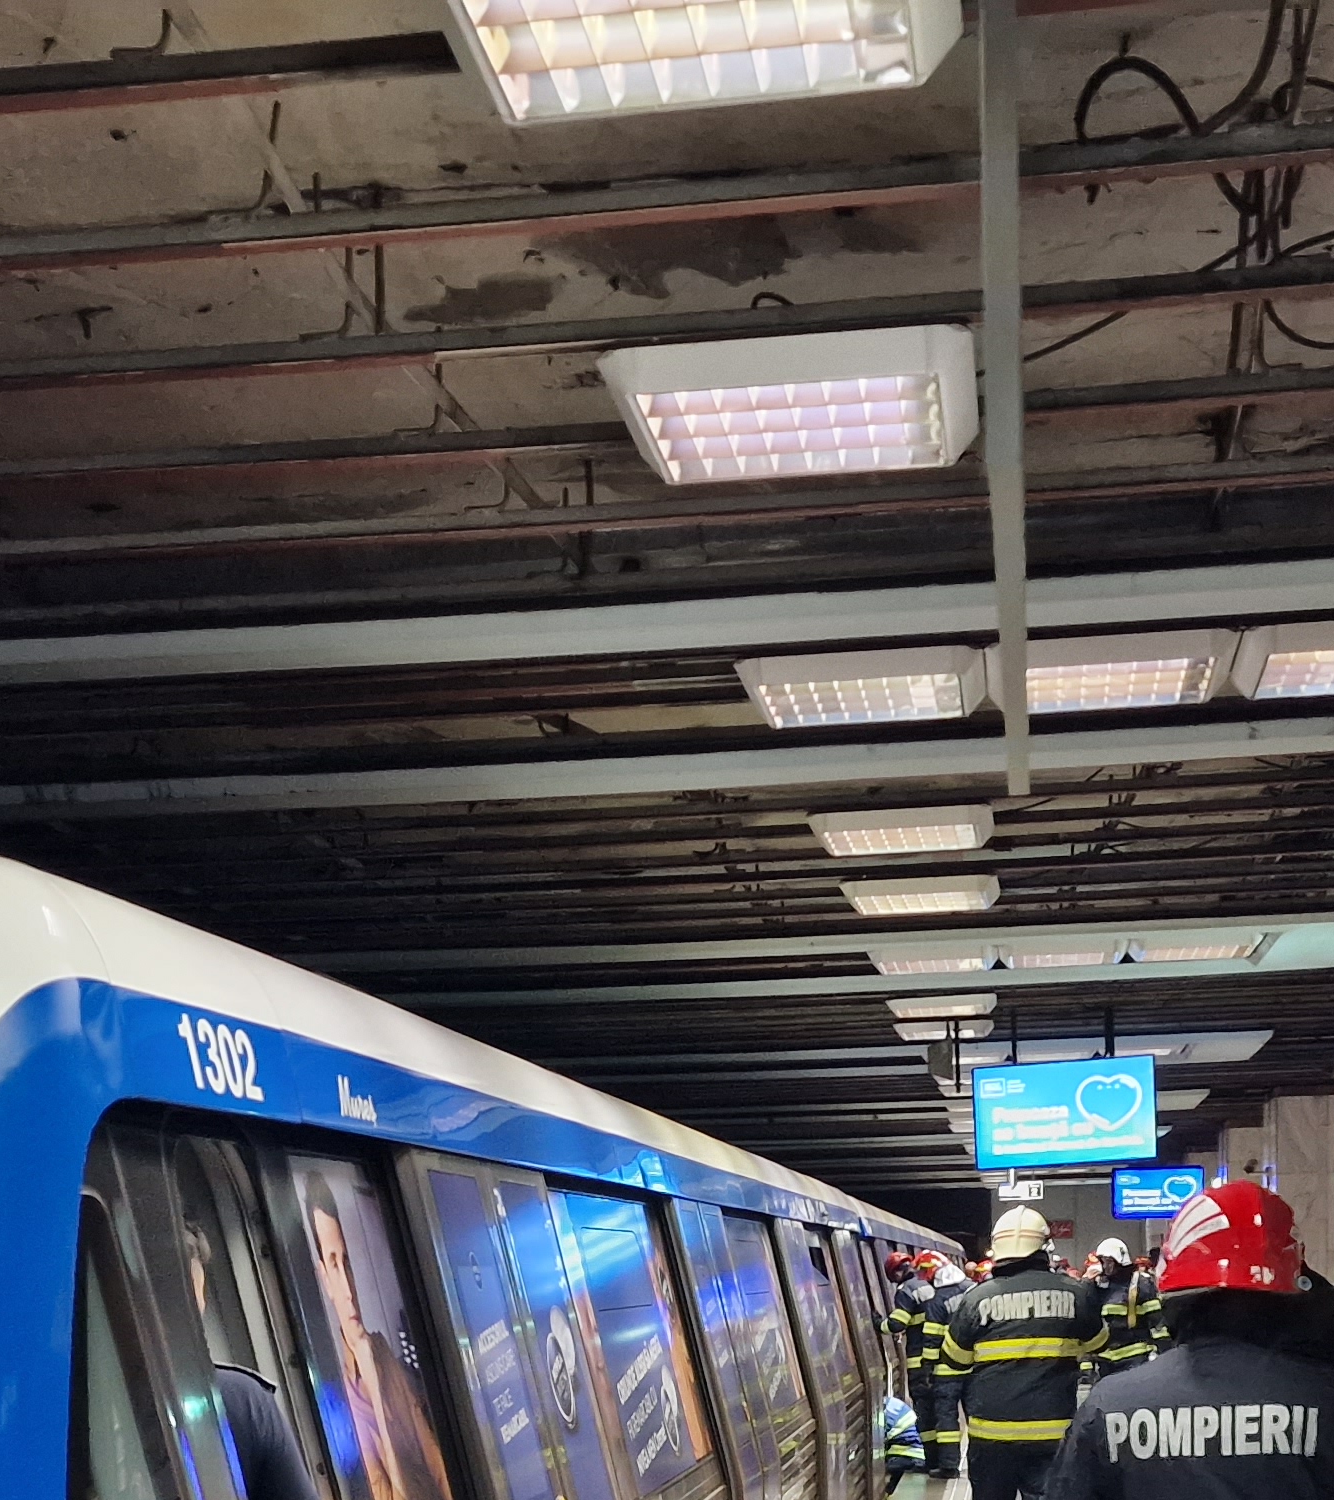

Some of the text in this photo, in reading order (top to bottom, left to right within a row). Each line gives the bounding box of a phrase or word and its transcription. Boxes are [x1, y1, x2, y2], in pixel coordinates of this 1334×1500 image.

[178, 1013, 264, 1102] 1302
[979, 1290, 1075, 1326] POMPIERII
[1105, 1403, 1319, 1464] POMPIERII
